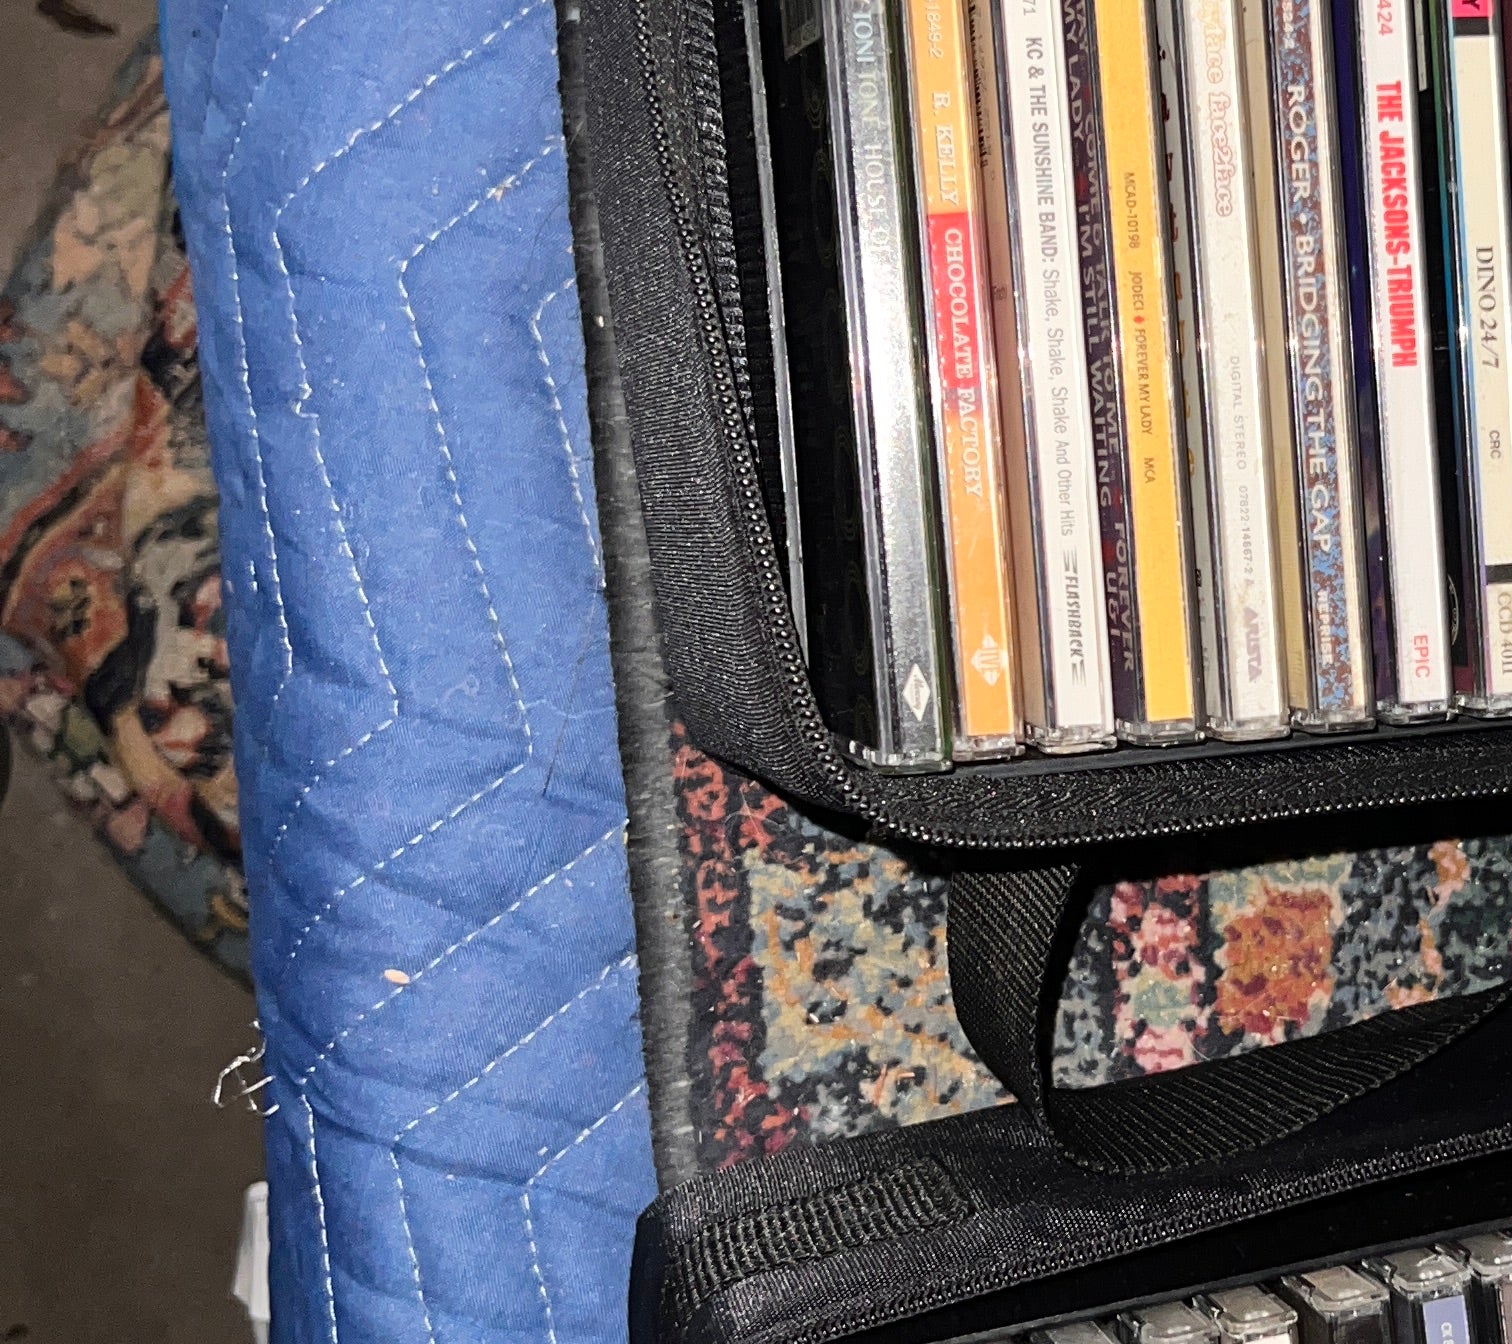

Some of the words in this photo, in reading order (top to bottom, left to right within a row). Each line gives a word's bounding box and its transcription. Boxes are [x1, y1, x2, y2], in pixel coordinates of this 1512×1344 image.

[1025, 36, 1045, 60] KC
[1027, 64, 1046, 79] &
[930, 91, 952, 114] R.
[1029, 83, 1049, 117] THE
[1376, 79, 1404, 123] THE
[931, 124, 958, 207] KELLY
[1032, 121, 1055, 206] SUNSHINE
[1288, 83, 1310, 202] ROGER
[1038, 211, 1059, 263] BAND:
[945, 227, 974, 379] CHOCOLATE
[1129, 271, 1144, 312] JODECI
[1476, 245, 1497, 312] DINO
[1295, 234, 1323, 402] BRIDGING
[1480, 318, 1500, 368] 24/7
[1134, 328, 1149, 380] FOREVER
[1138, 384, 1150, 402] MY
[957, 386, 983, 496] FACTORY
[1139, 405, 1152, 435] LADY
[1305, 416, 1328, 473] THE
[1310, 483, 1332, 553] GAP
